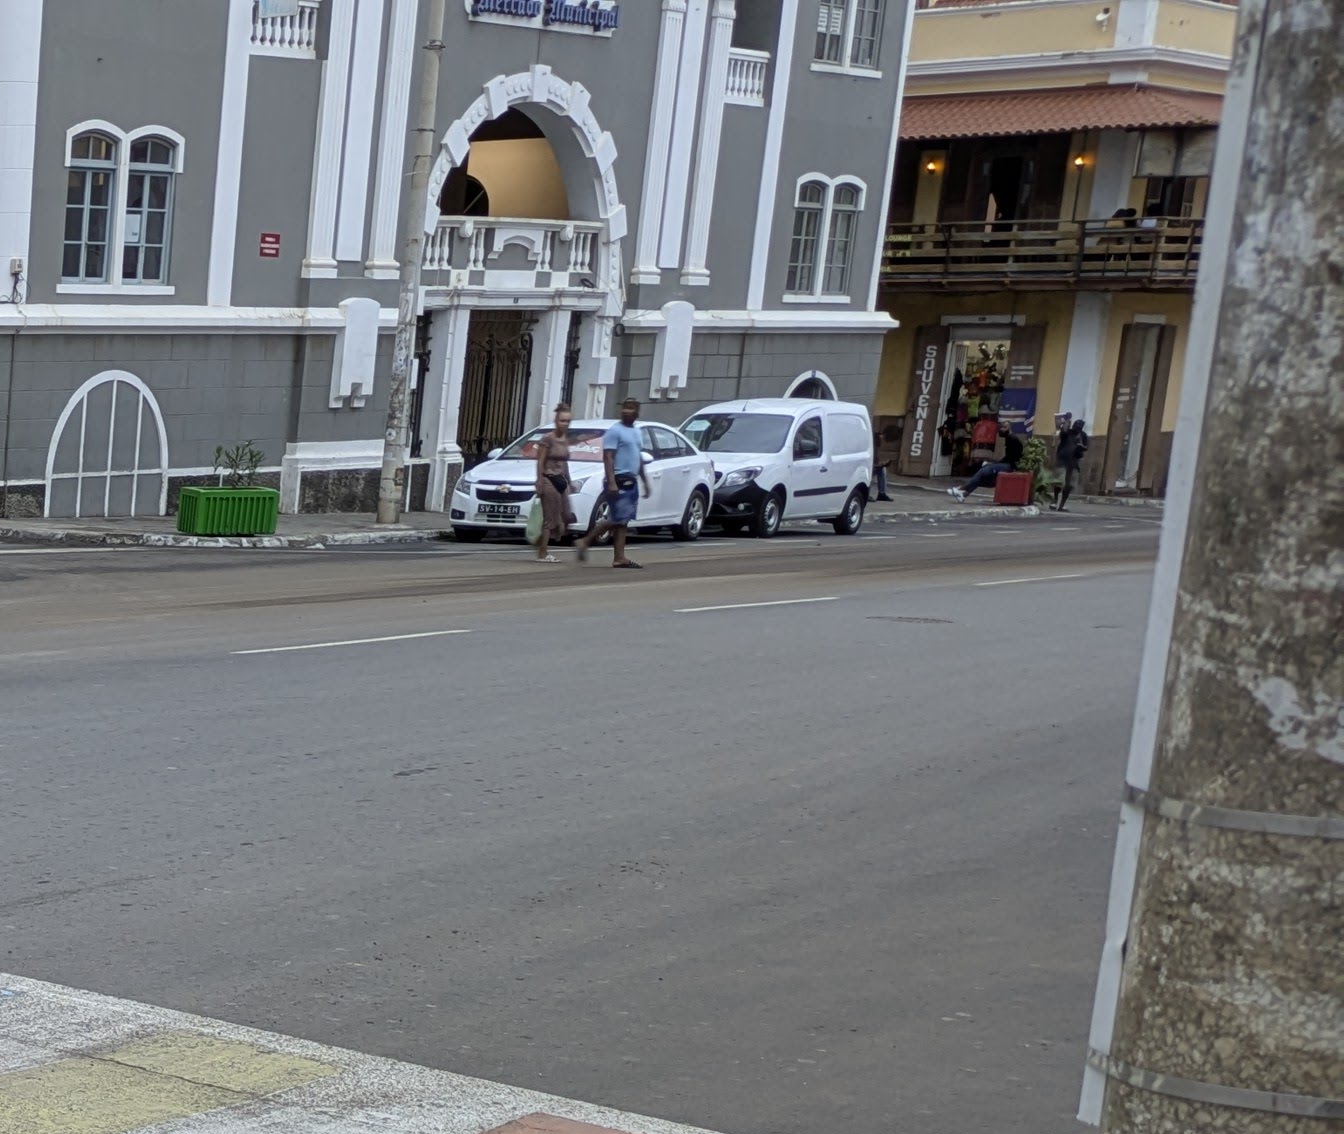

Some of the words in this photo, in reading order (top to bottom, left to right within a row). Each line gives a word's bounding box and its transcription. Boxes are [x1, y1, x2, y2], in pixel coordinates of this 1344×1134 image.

[543, 0, 619, 31] Municipal
[910, 345, 938, 456] SOUVENIRS
[479, 505, 519, 514] SV-14-EH
